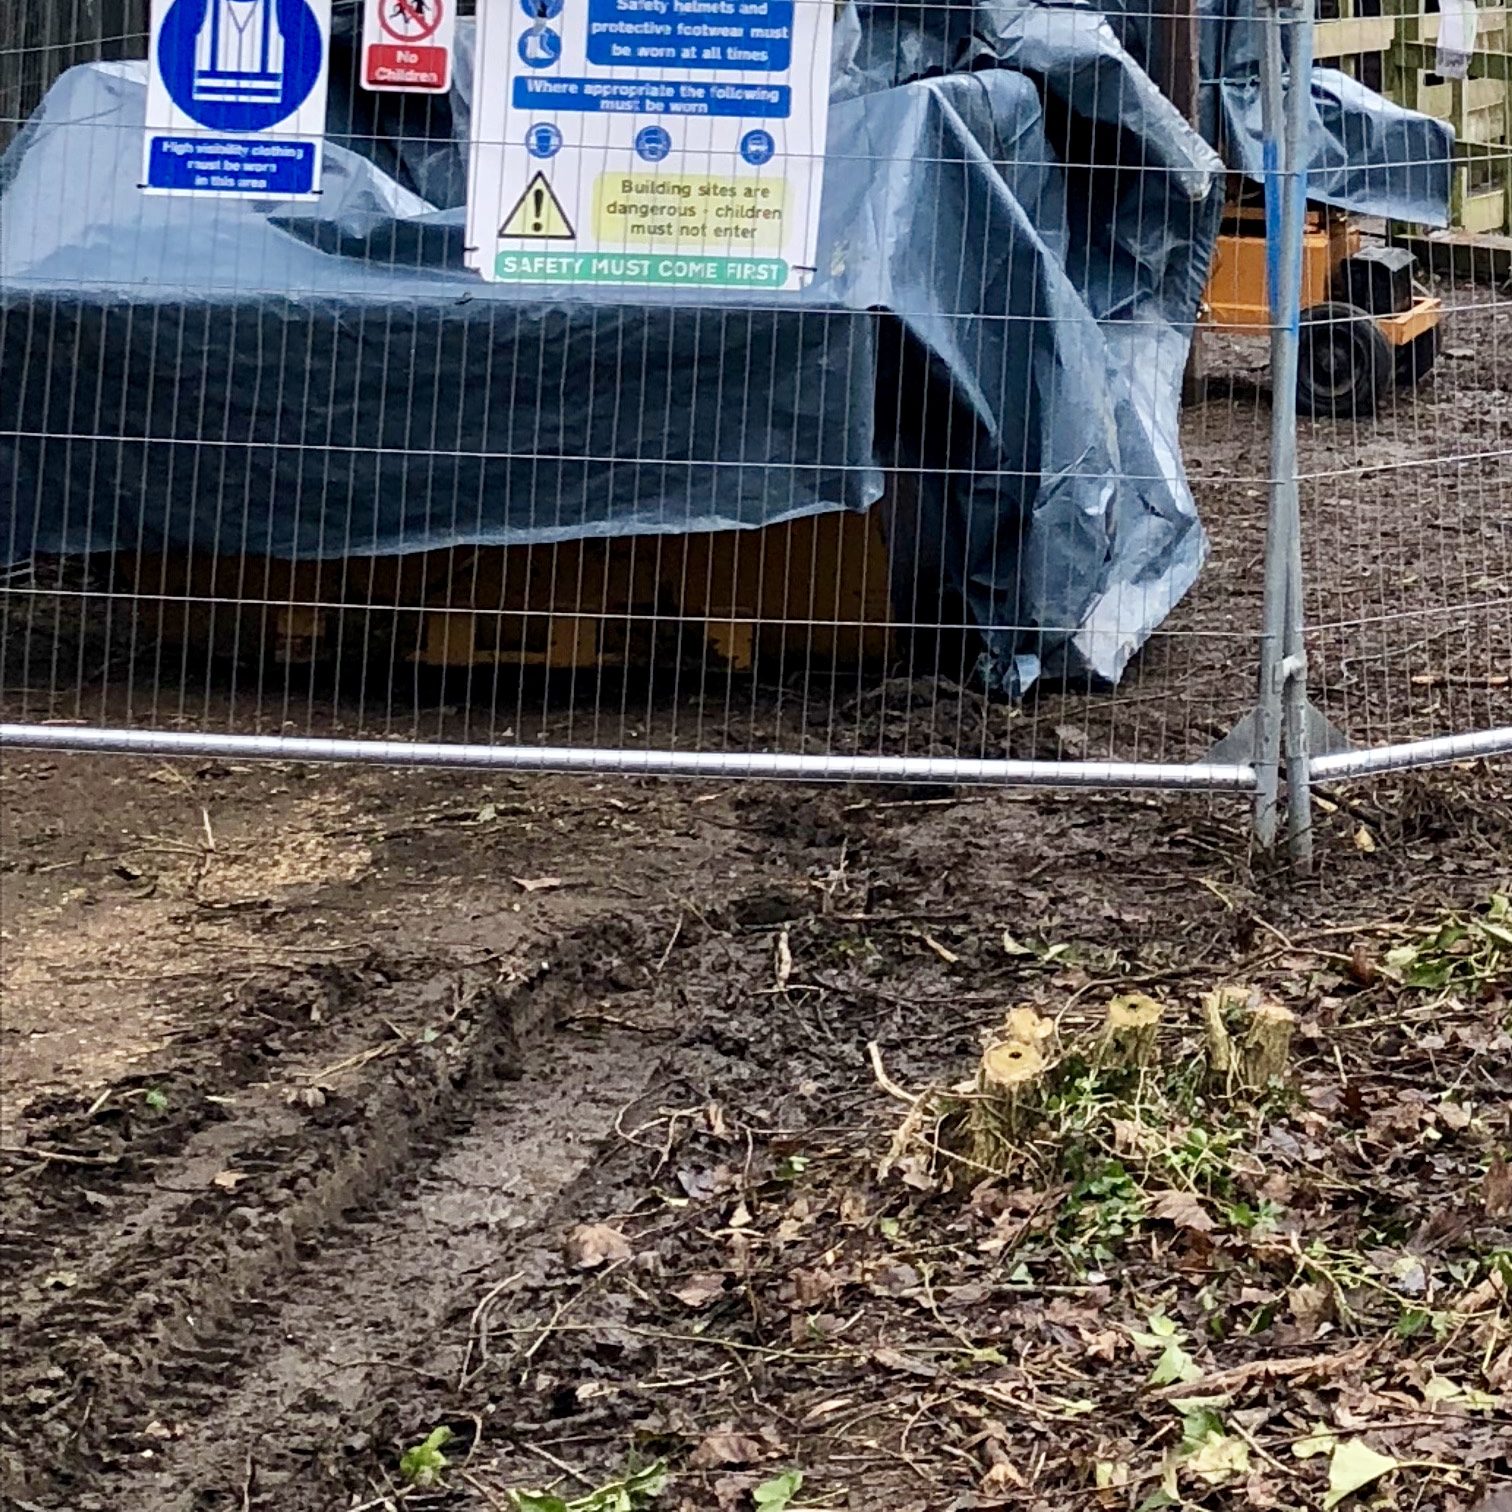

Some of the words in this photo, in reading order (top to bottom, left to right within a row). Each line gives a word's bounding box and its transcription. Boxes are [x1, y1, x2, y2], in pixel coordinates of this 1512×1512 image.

[673, 0, 734, 14] helmets
[739, 2, 768, 15] and
[591, 21, 671, 36] protective
[677, 23, 744, 37] footwear
[750, 26, 789, 39] must
[396, 50, 419, 64] No
[612, 43, 632, 56] be
[637, 46, 675, 58] worn
[681, 46, 697, 59] at
[702, 47, 722, 60] all
[727, 47, 769, 62] times
[374, 66, 438, 83] Children
[526, 79, 579, 94] Where
[583, 83, 675, 98] appropriate
[679, 85, 705, 98] the
[710, 86, 779, 103] following
[600, 99, 640, 111] must
[645, 99, 665, 111] be
[669, 102, 708, 113] worn
[162, 141, 194, 156] High
[252, 146, 304, 160] clothing
[187, 160, 221, 171] must
[223, 160, 241, 172] be
[243, 163, 277, 173] worn
[194, 175, 208, 186] in
[210, 176, 235, 187] this
[237, 179, 267, 188] area
[621, 180, 691, 198] Building
[698, 182, 736, 197] sites
[743, 185, 771, 198] are
[606, 201, 696, 218] dangerous
[715, 204, 782, 219] children
[630, 222, 672, 236] must
[680, 224, 707, 237] not
[714, 225, 757, 238] enter
[503, 257, 584, 274] SAFETY
[591, 258, 650, 276] MUST
[658, 260, 717, 278] COME
[727, 263, 780, 280] FIRST
